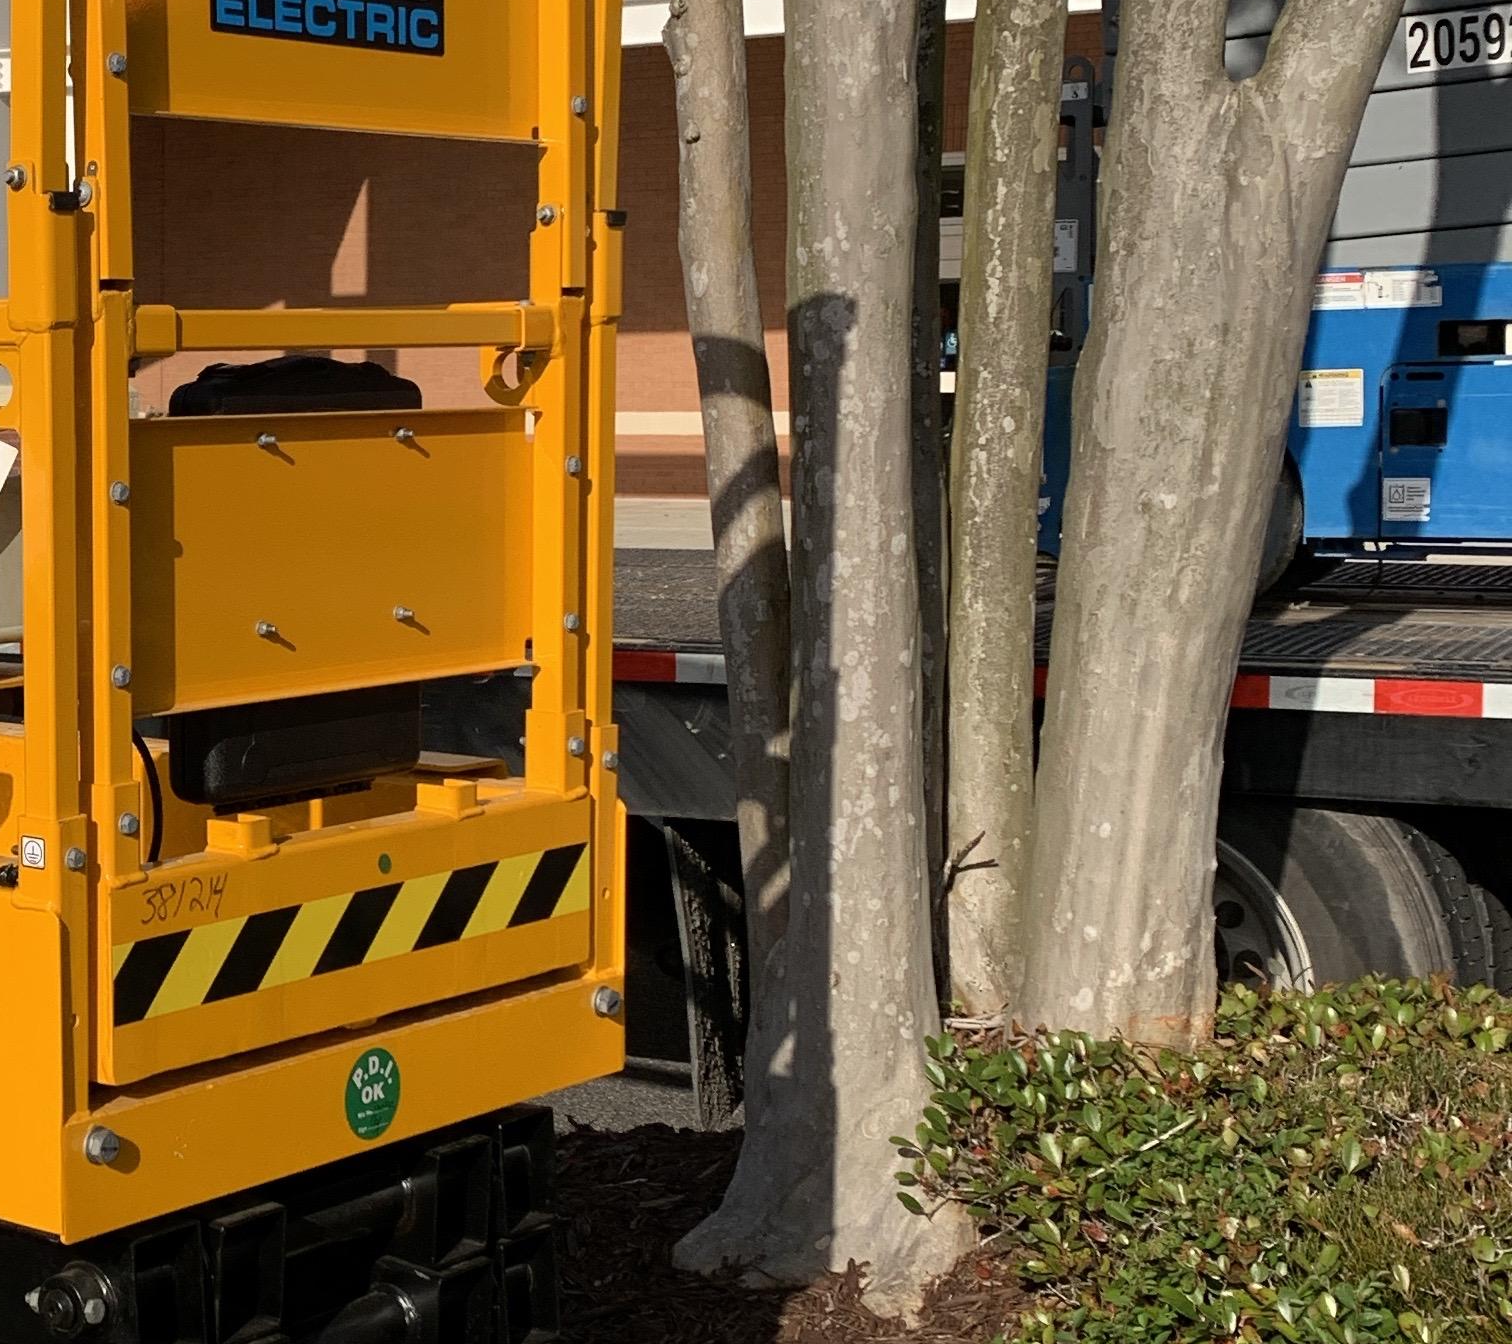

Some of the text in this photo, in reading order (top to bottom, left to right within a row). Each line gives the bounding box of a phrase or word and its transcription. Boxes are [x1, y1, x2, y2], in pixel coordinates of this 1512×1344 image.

[1408, 12, 1512, 69] 2059
[140, 872, 229, 925] 381214
[352, 1055, 394, 1090] P.D.I.
[361, 1081, 385, 1105] OK
